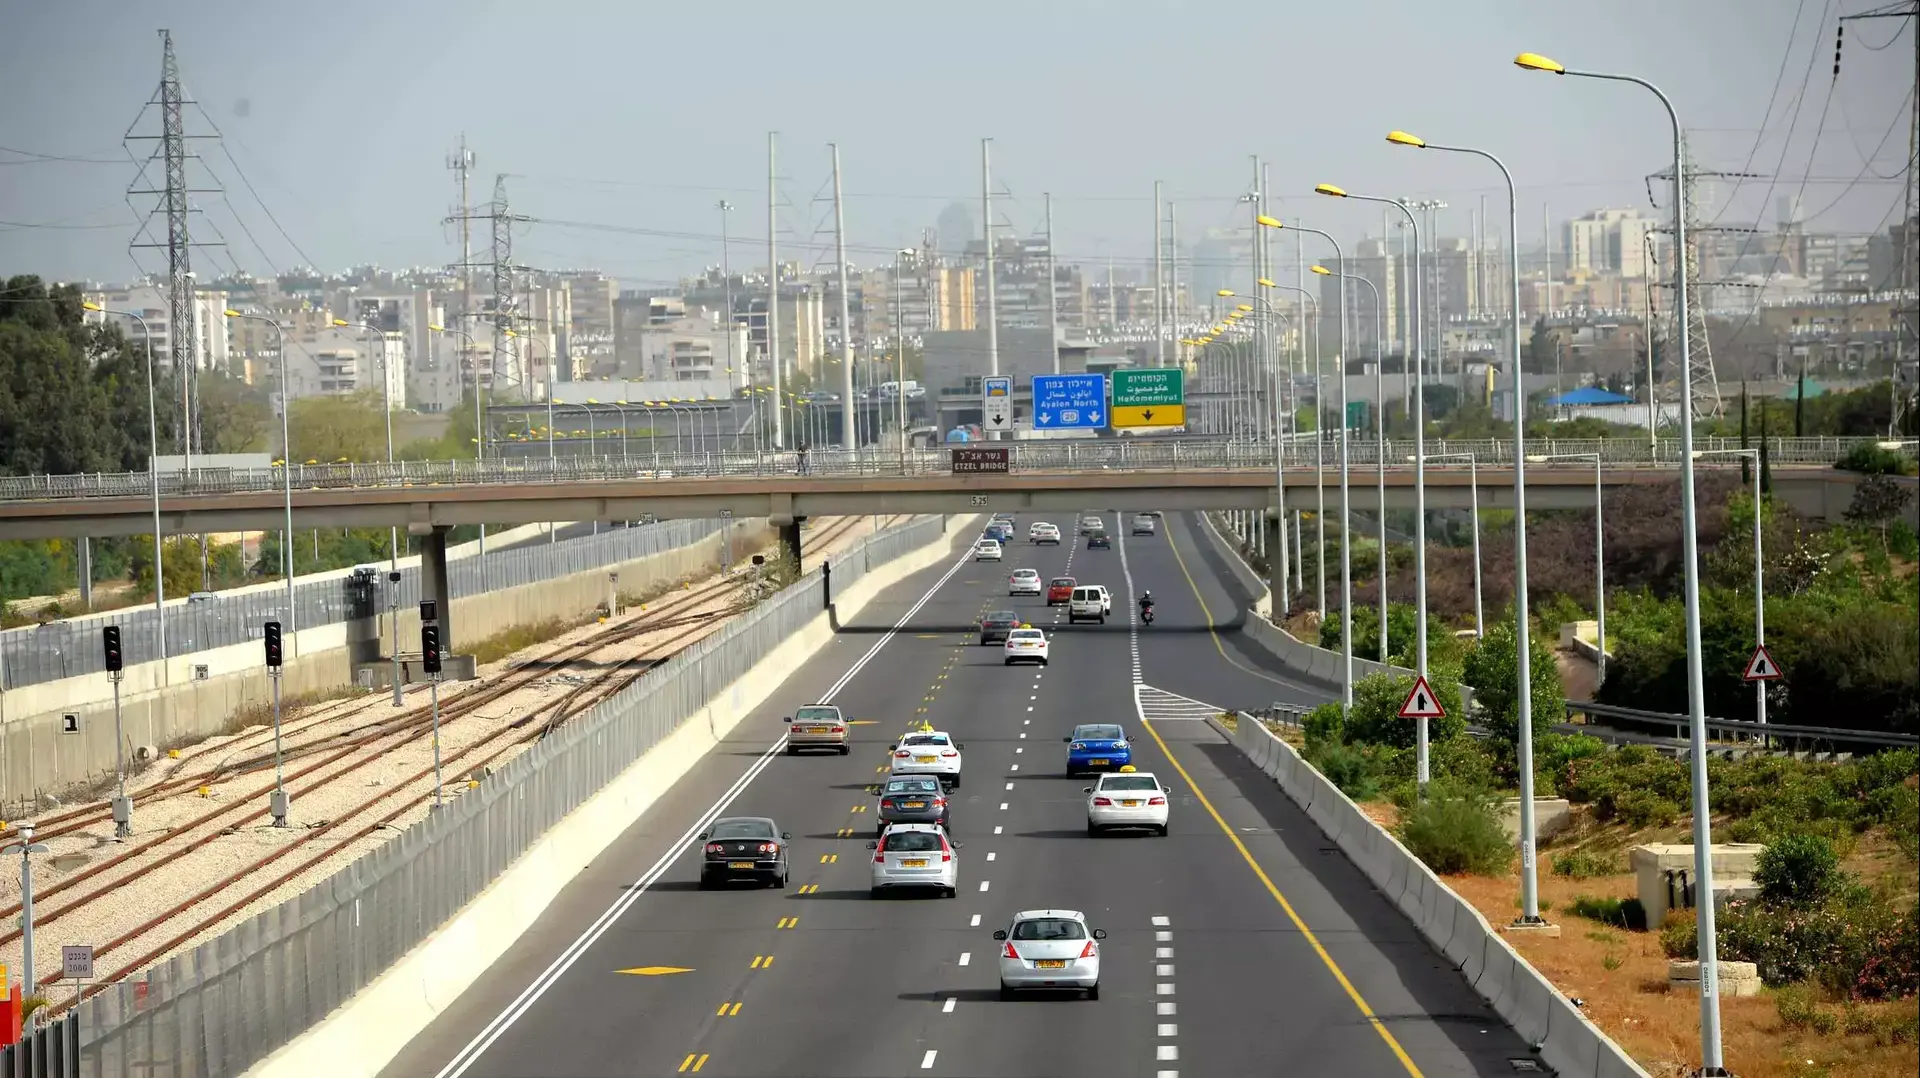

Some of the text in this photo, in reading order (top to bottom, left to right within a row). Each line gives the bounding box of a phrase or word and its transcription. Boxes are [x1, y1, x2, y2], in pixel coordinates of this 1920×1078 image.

[1127, 374, 1167, 383] הקוממיות
[1045, 379, 1093, 389] איילון צפון
[1117, 394, 1178, 403] HaKomemiyut
[1041, 401, 1070, 409] Ayalon
[1064, 412, 1076, 420] 20
[985, 452, 1001, 460] גשר
[954, 462, 1007, 470] ETZEL BRIDGE
[972, 496, 987, 505] 5.25
[64, 715, 78, 732] ב
[68, 964, 88, 973] 2000
